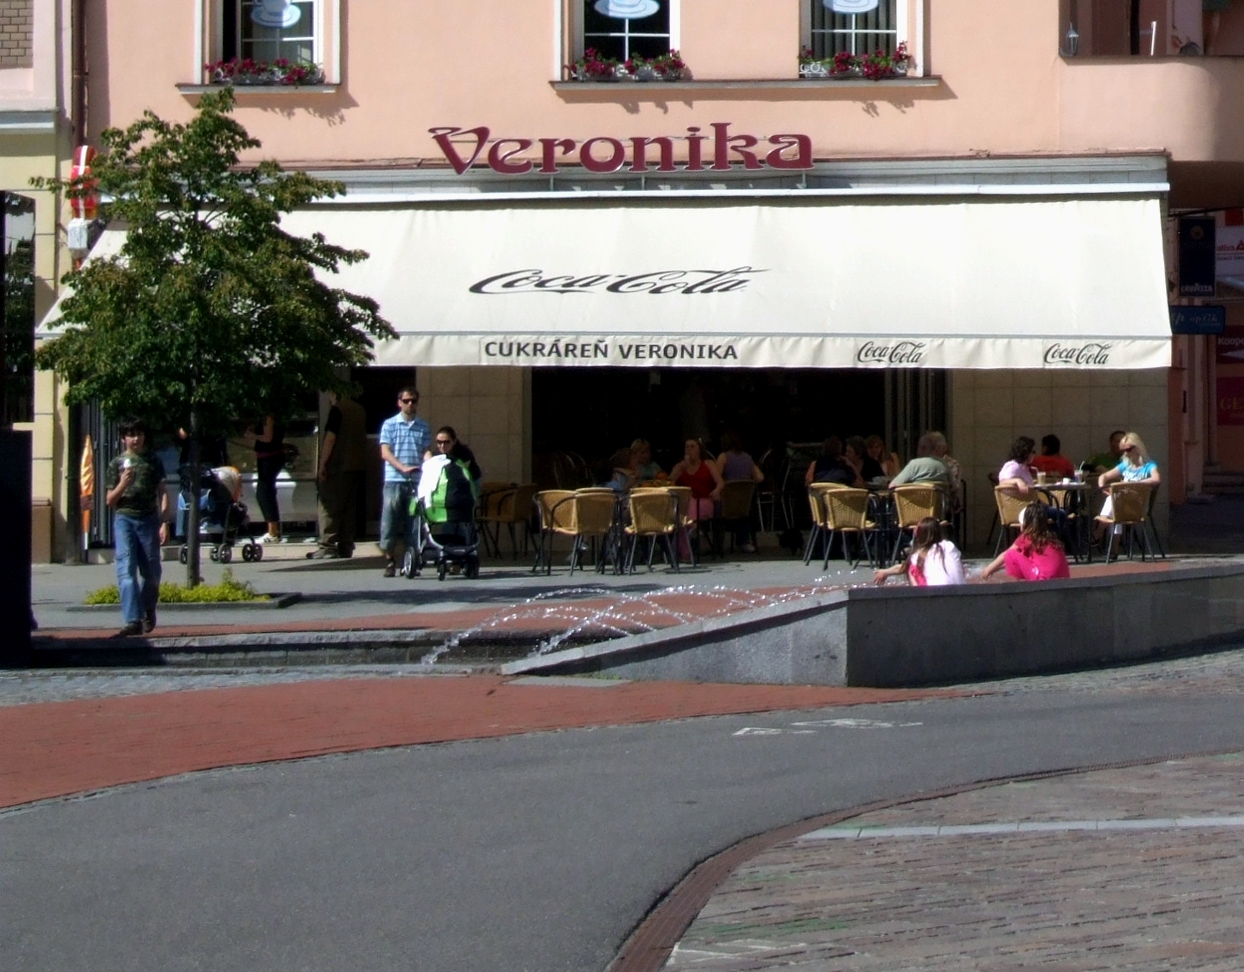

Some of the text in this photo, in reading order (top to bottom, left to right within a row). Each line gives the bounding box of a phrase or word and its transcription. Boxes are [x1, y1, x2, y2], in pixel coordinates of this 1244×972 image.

[429, 122, 814, 175] Veronika
[469, 264, 771, 297] Coca-Cola
[484, 336, 738, 361] CUKRÁREŇ VERONIKA
[857, 339, 927, 365] Coca-Cola
[1043, 339, 1110, 365] Coca-Cola
